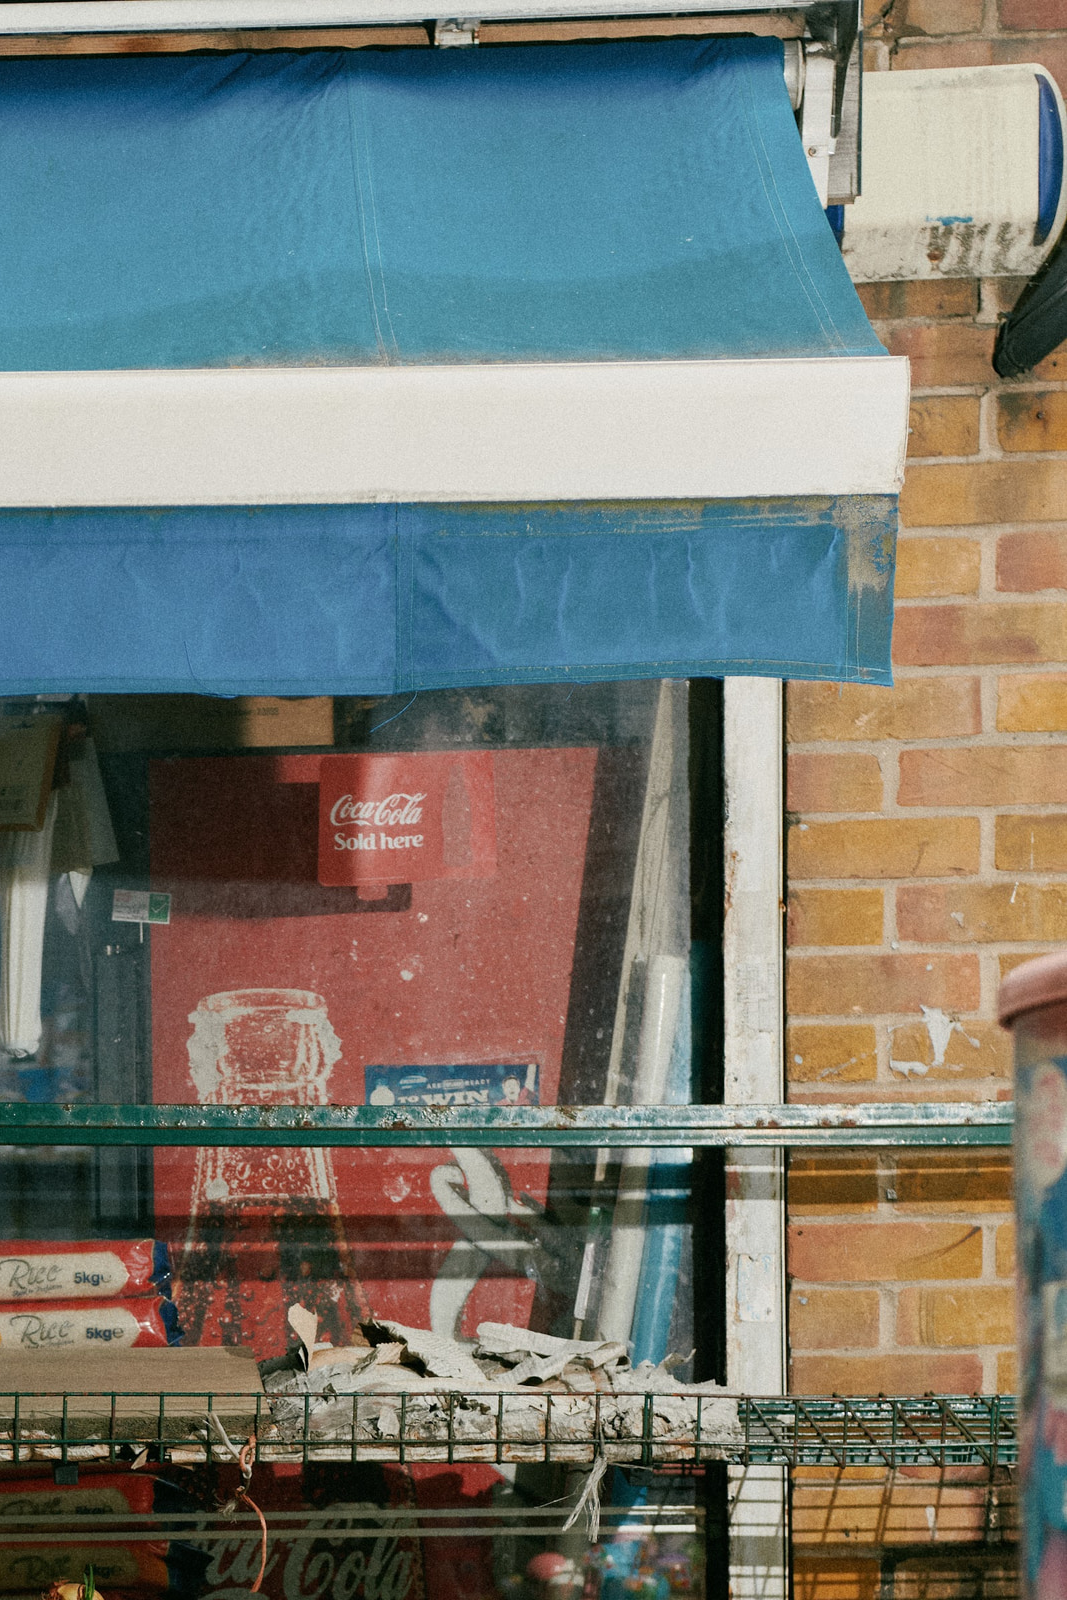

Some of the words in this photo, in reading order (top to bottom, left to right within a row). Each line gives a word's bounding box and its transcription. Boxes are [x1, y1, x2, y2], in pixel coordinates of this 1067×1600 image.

[330, 792, 427, 827] Coca-Cola
[334, 832, 376, 851] Sold
[380, 832, 424, 850] here
[421, 1090, 488, 1106] WIN
